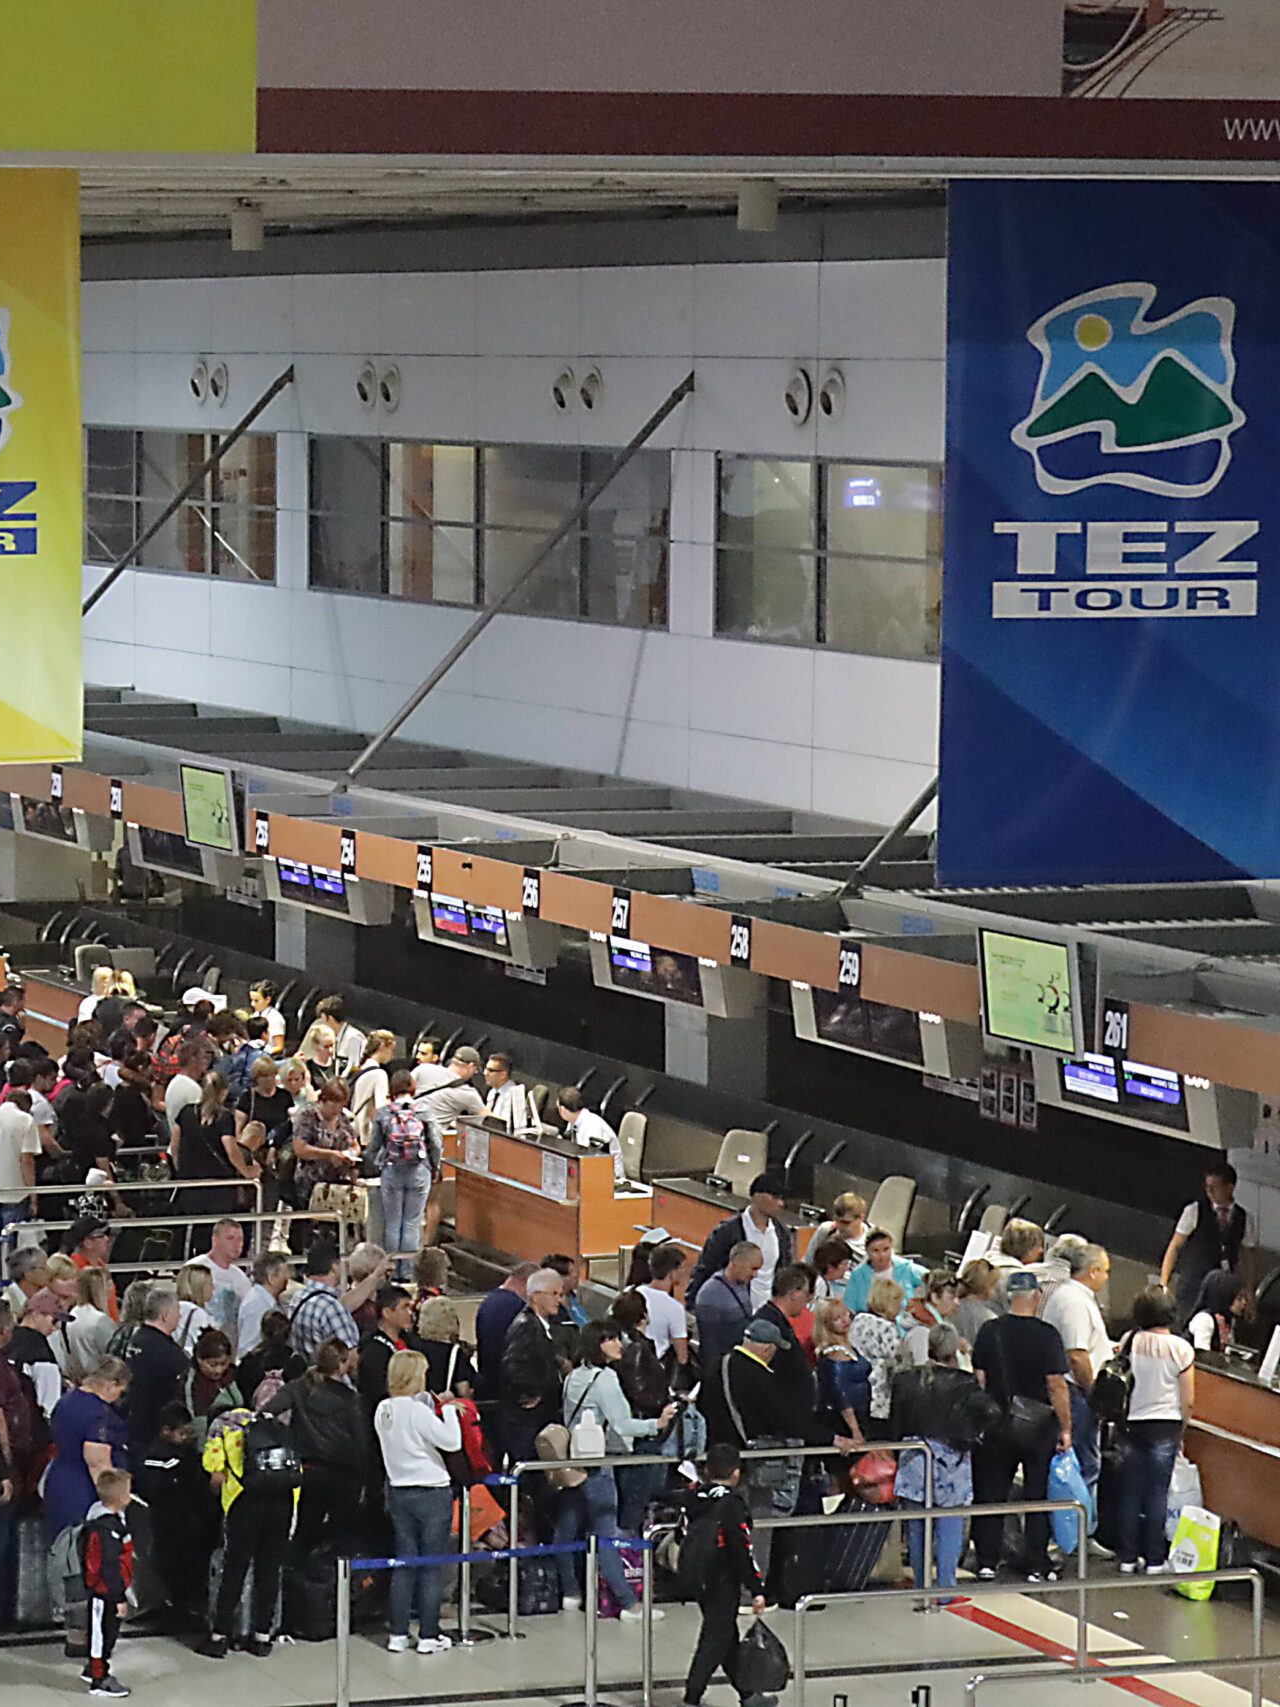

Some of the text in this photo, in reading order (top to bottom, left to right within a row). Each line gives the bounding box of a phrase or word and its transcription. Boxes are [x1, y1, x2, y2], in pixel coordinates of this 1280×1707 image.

[1224, 118, 1280, 141] ww
[993, 520, 1260, 575] TEZ
[1020, 586, 1231, 612] TOUR
[612, 896, 630, 930] 257
[730, 924, 750, 960] 258
